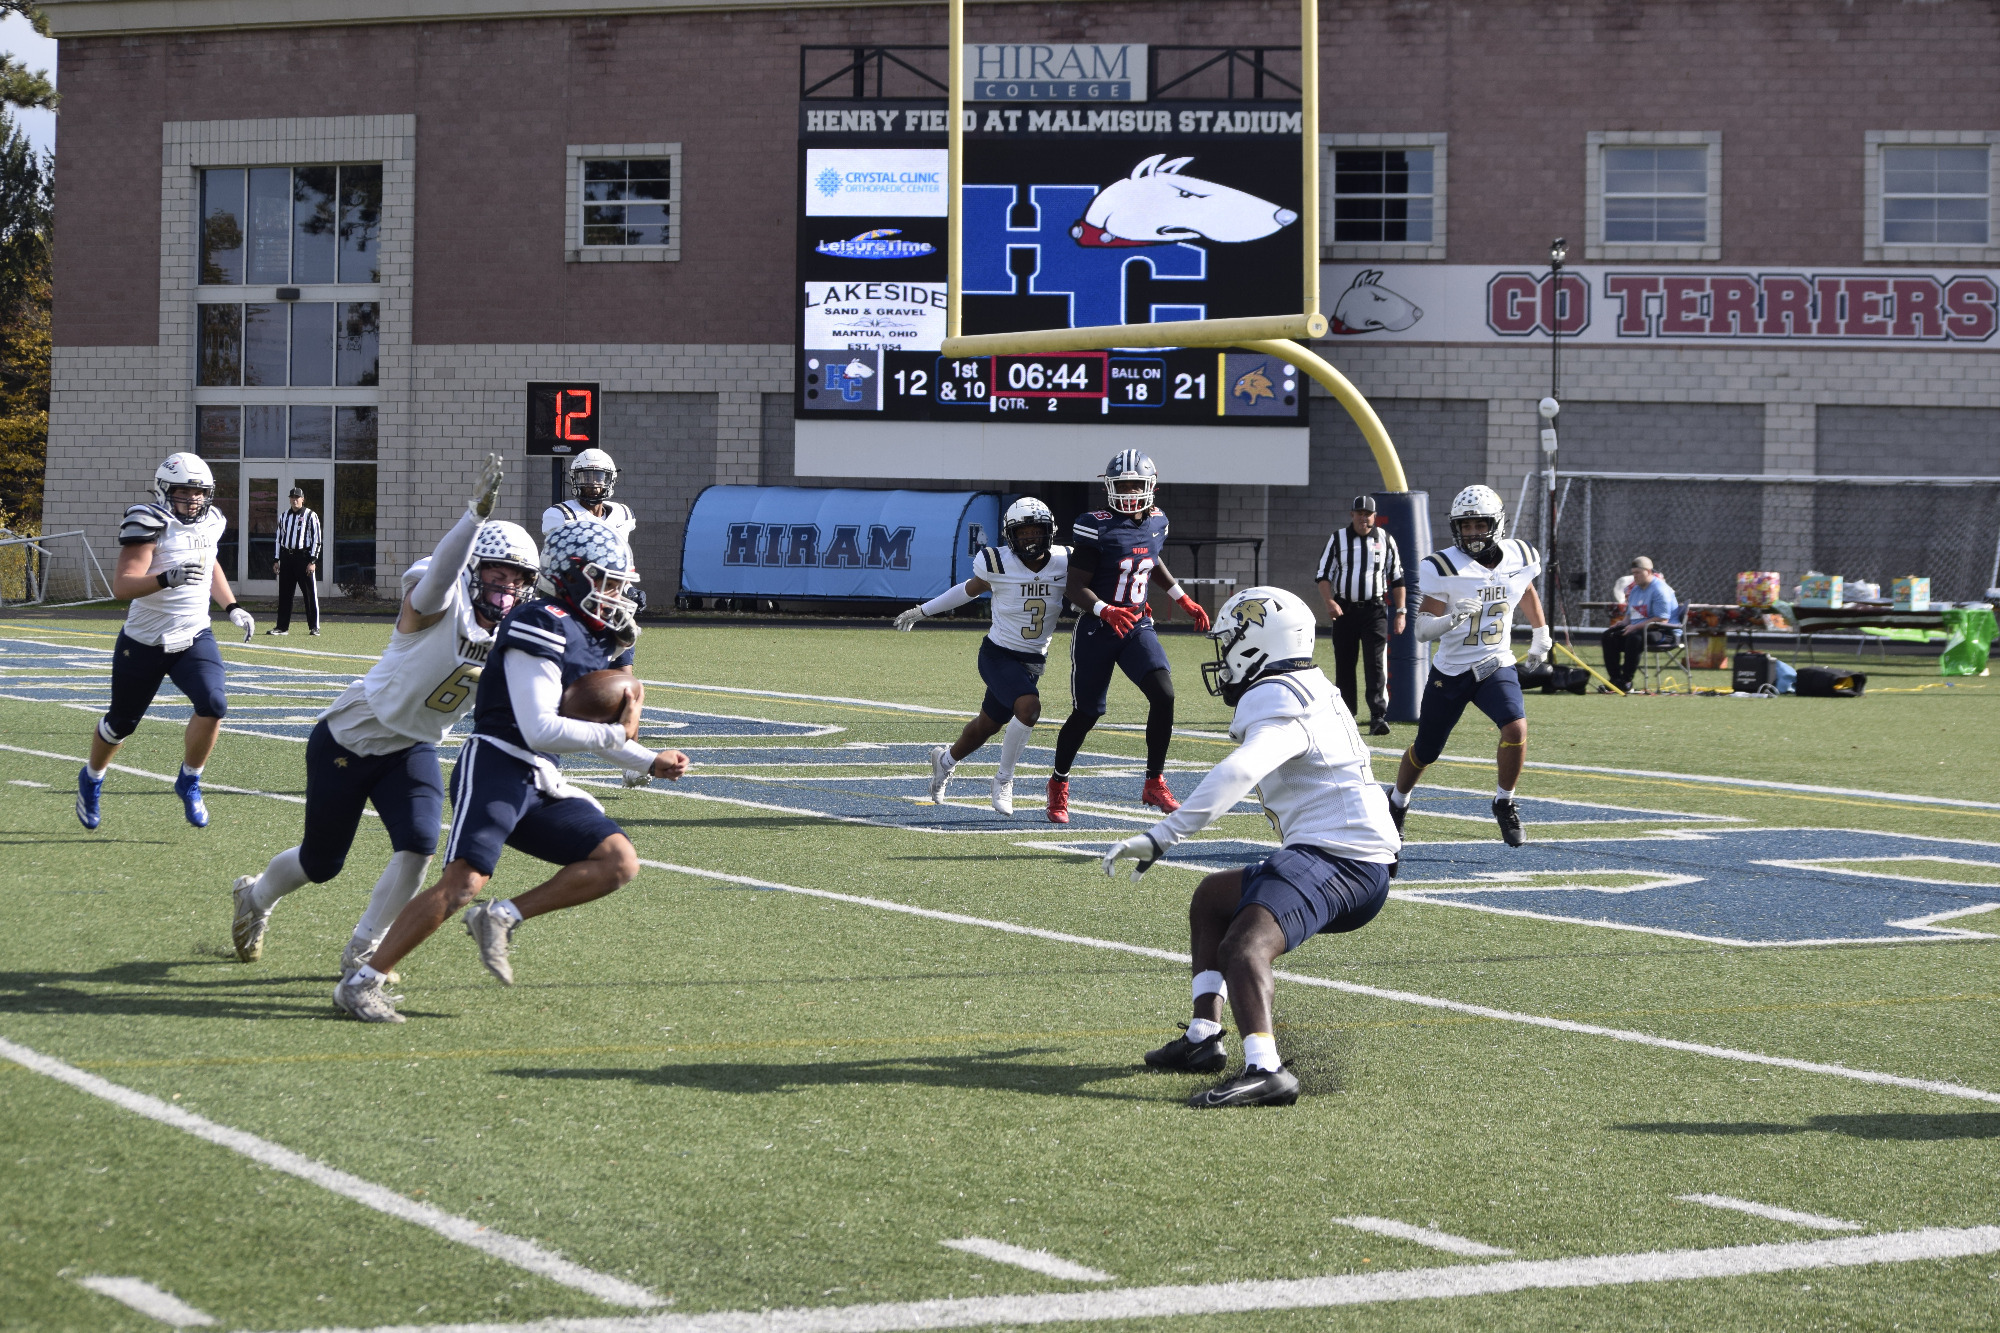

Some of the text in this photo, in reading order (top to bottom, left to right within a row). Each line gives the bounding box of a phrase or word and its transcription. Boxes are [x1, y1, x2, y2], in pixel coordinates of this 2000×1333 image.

[974, 45, 1131, 79] HIRAM
[985, 84, 1120, 97] COLLEGE
[807, 110, 1302, 133] HENRY FIED AT MALMISUR STADIUM
[845, 172, 940, 183] CRYSTAL CLINIC
[845, 184, 940, 193] ORTHOPAEDIC CENTER
[819, 239, 932, 252] LeisureTime
[805, 283, 947, 310] LAKESIDE
[1486, 272, 1998, 341] GO TERRIERS
[876, 308, 927, 316] GRAVEL
[832, 330, 885, 338] MANTUA,
[952, 361, 979, 378] 1st
[1008, 363, 1089, 389] 06:44
[1111, 368, 1161, 379] BALL ON
[894, 370, 927, 395] 12
[940, 382, 985, 400] & 10
[1125, 384, 1148, 401] 18
[1174, 373, 1206, 400] 21
[556, 389, 592, 441] 12
[998, 398, 1058, 411] QTR. 2
[723, 522, 916, 571] HIRAM
[1020, 584, 1051, 597] THIEL
[1114, 557, 1155, 605] 18
[1477, 586, 1507, 602] THIEL
[1021, 598, 1046, 640] 3
[1463, 602, 1511, 647] 13
[458, 636, 489, 662] THIE
[425, 662, 483, 713] 6
